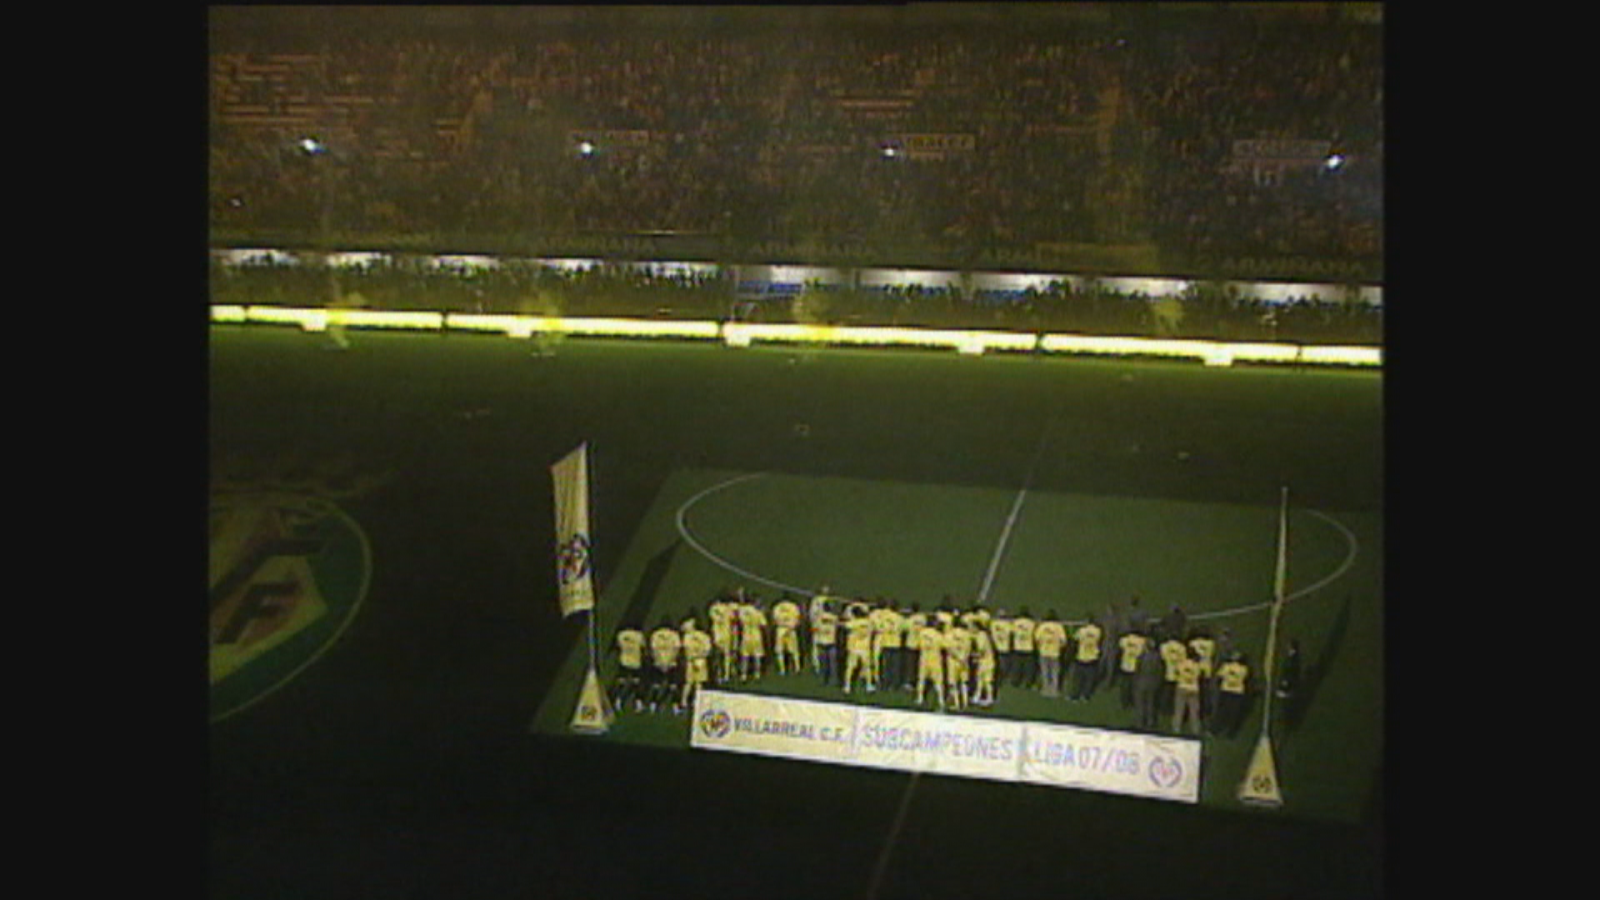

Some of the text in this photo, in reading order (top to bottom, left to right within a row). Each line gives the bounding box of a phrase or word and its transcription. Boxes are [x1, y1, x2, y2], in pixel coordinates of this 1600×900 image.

[733, 715, 814, 741] VILLARREAL
[862, 722, 1013, 761] SUBCAMPEONES
[1032, 740, 1075, 767] LIGA
